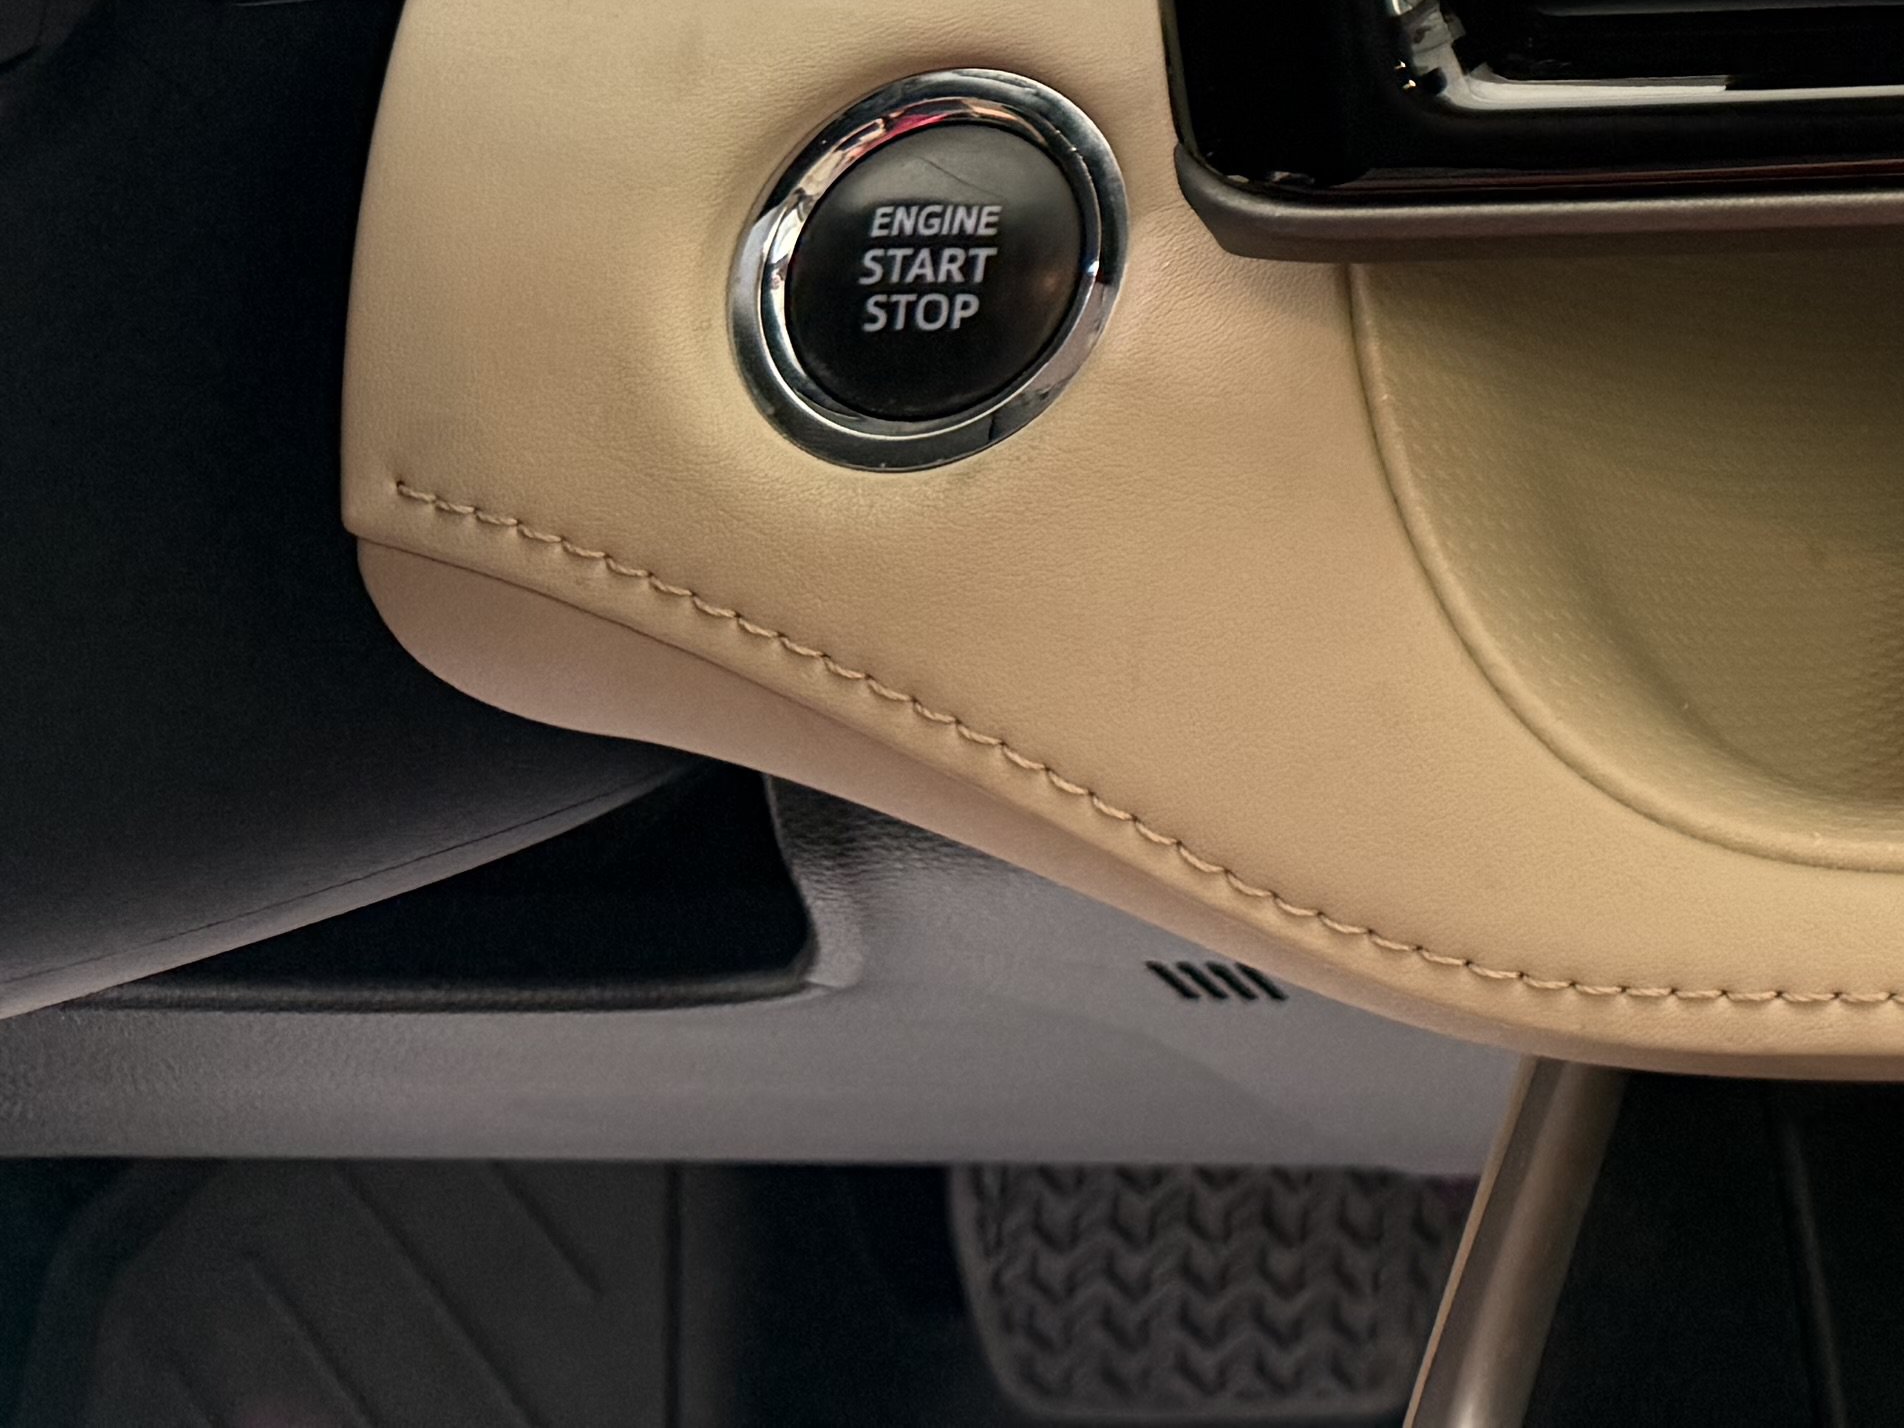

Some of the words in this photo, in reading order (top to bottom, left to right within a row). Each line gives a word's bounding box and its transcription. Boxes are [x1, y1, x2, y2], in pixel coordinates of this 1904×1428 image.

[871, 204, 1002, 238] ENGINE
[858, 247, 997, 286] START
[863, 293, 979, 332] STOP
